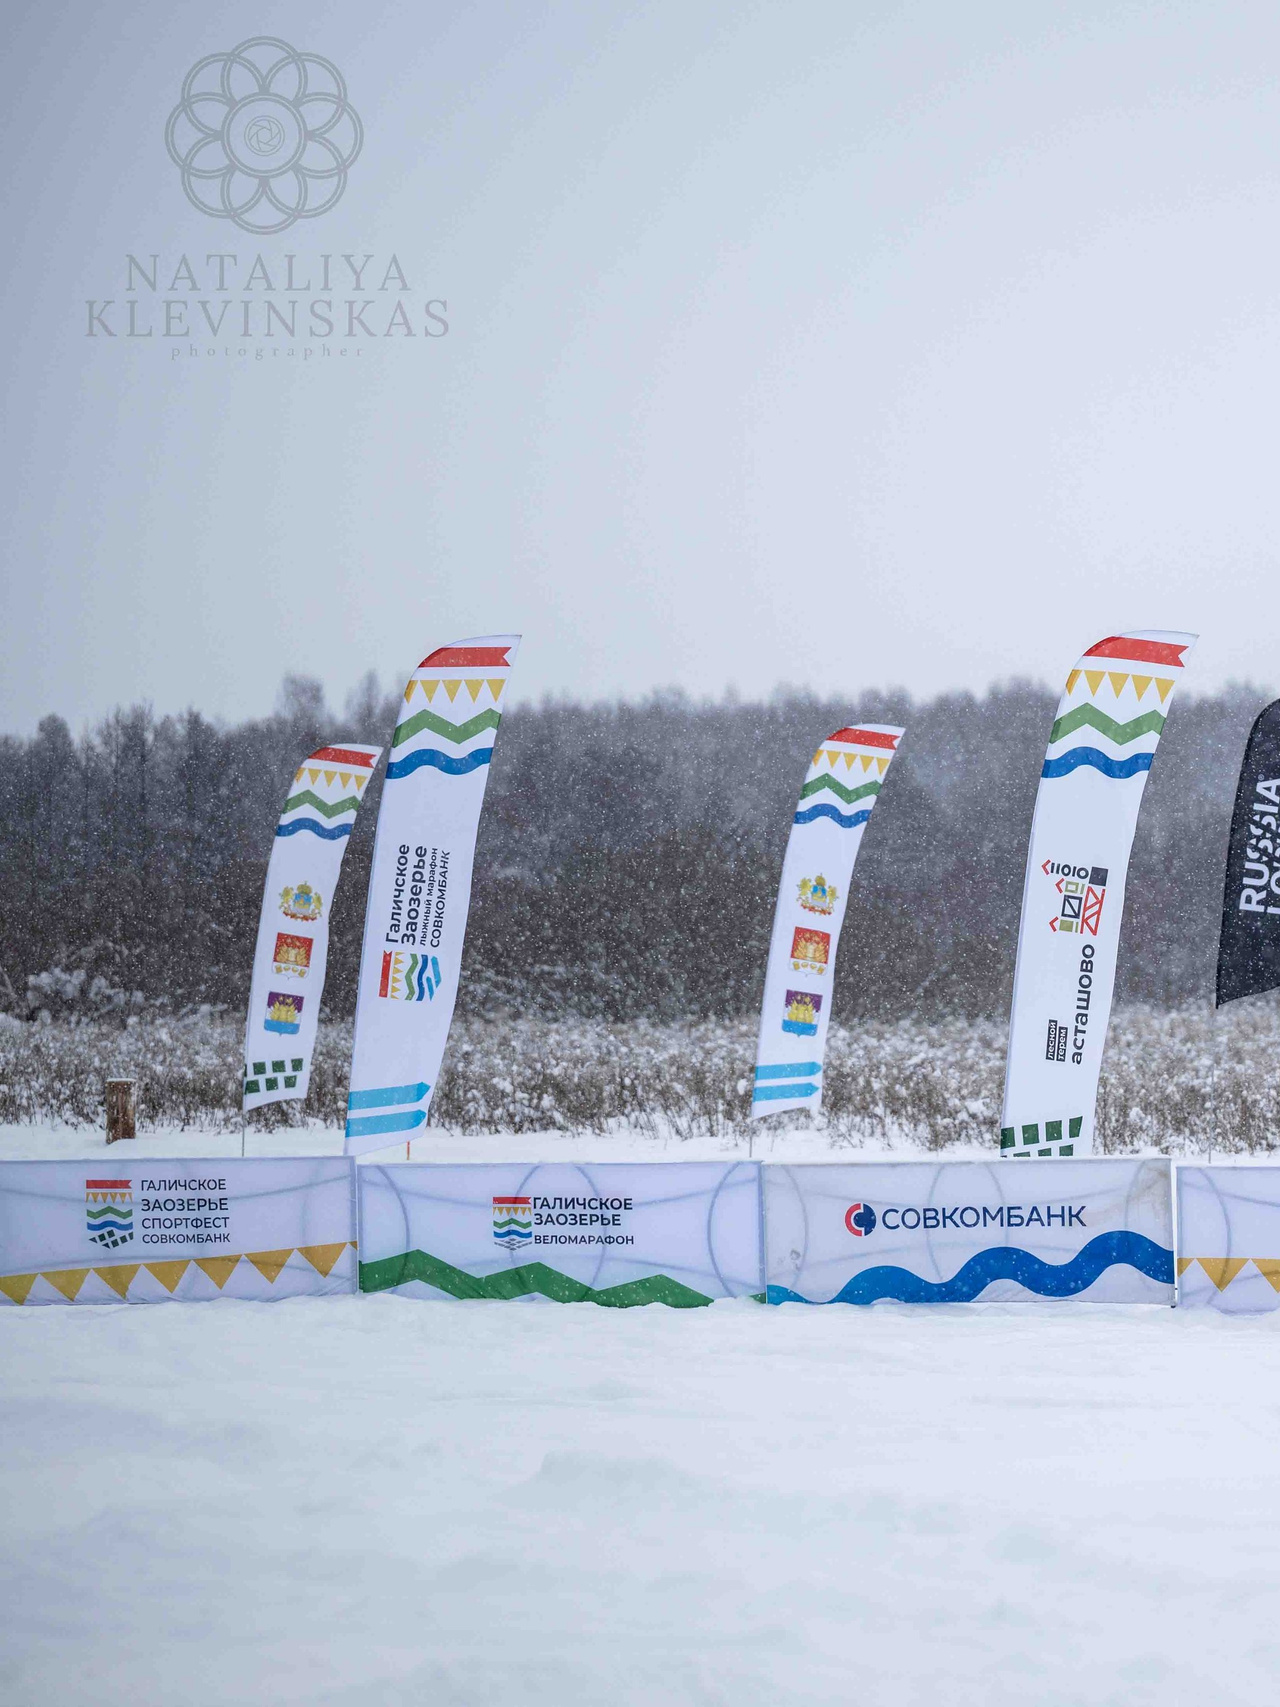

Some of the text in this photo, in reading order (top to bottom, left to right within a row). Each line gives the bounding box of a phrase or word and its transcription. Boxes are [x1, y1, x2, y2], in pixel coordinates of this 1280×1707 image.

[385, 844, 410, 943] Галичское
[401, 845, 428, 946] Заозерье
[420, 847, 438, 947] лыжный марафон
[430, 850, 451, 948] СОВКОМБАНК
[1071, 943, 1096, 1065] асташово
[141, 1178, 227, 1192] ГАЛИЧСКОЕ
[141, 1198, 229, 1212] ЗАОЗЕРЬЕ
[533, 1197, 633, 1211] ГАЛИЧСКОЕ
[141, 1217, 230, 1229] СПОРТФЕСТ
[534, 1213, 622, 1227] ЗАОЗЕРЬЕ
[882, 1205, 1087, 1230] СОВКОМБАНК
[142, 1233, 231, 1244] СОВКОМБАНК
[534, 1235, 634, 1245] ВЕЛОМАРАФОН
